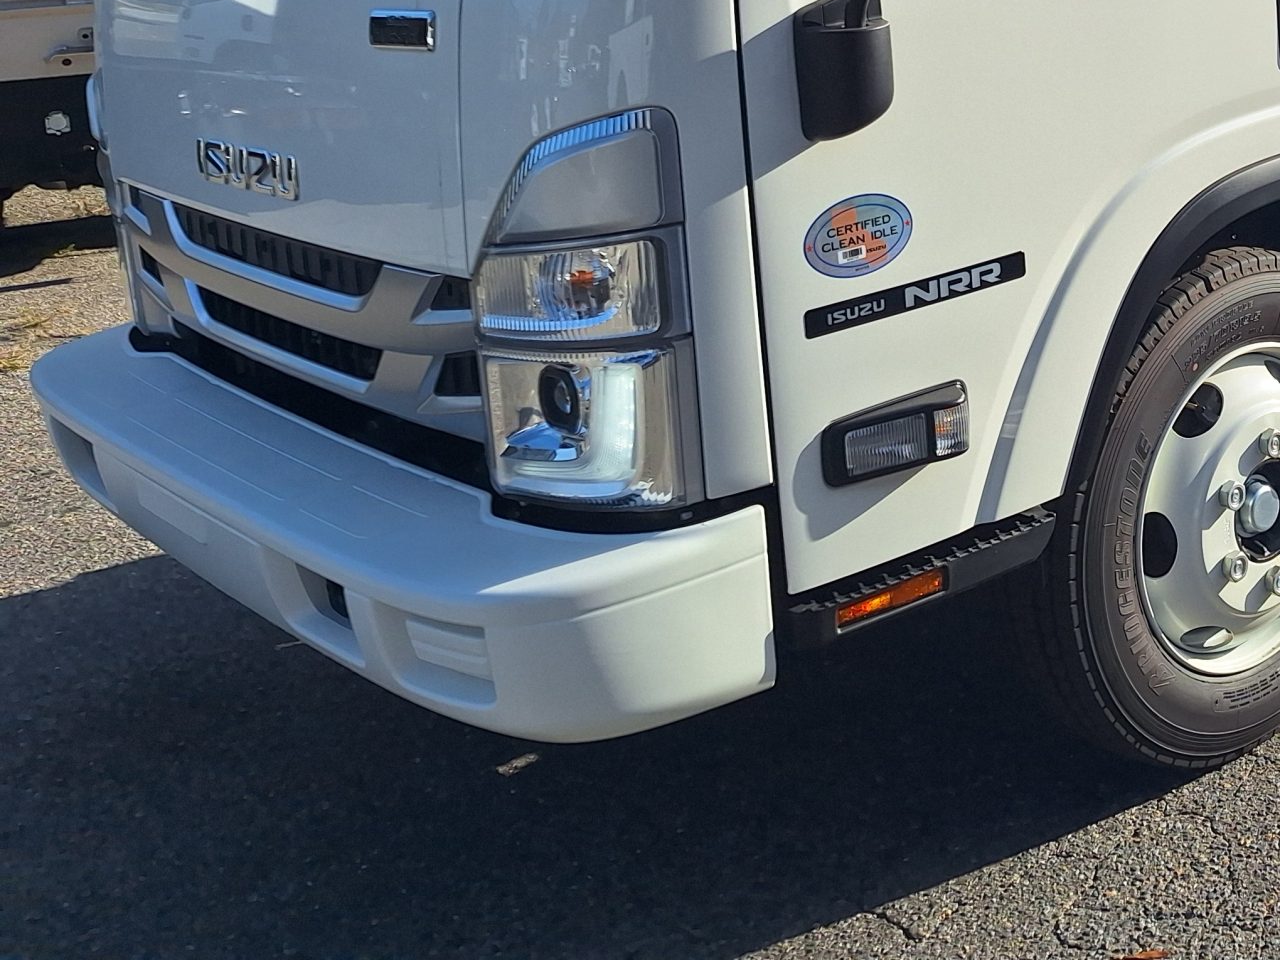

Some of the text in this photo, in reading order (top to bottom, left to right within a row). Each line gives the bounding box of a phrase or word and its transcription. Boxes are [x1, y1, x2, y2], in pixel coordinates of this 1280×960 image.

[196, 137, 300, 202] ISUZU
[821, 225, 899, 253] CLEAN IDLE
[826, 214, 892, 239] CERTIFIED
[866, 243, 887, 254] ISUZU
[827, 262, 1002, 326] ISUZU NRR
[1114, 431, 1176, 696] BRIDGESTONE
